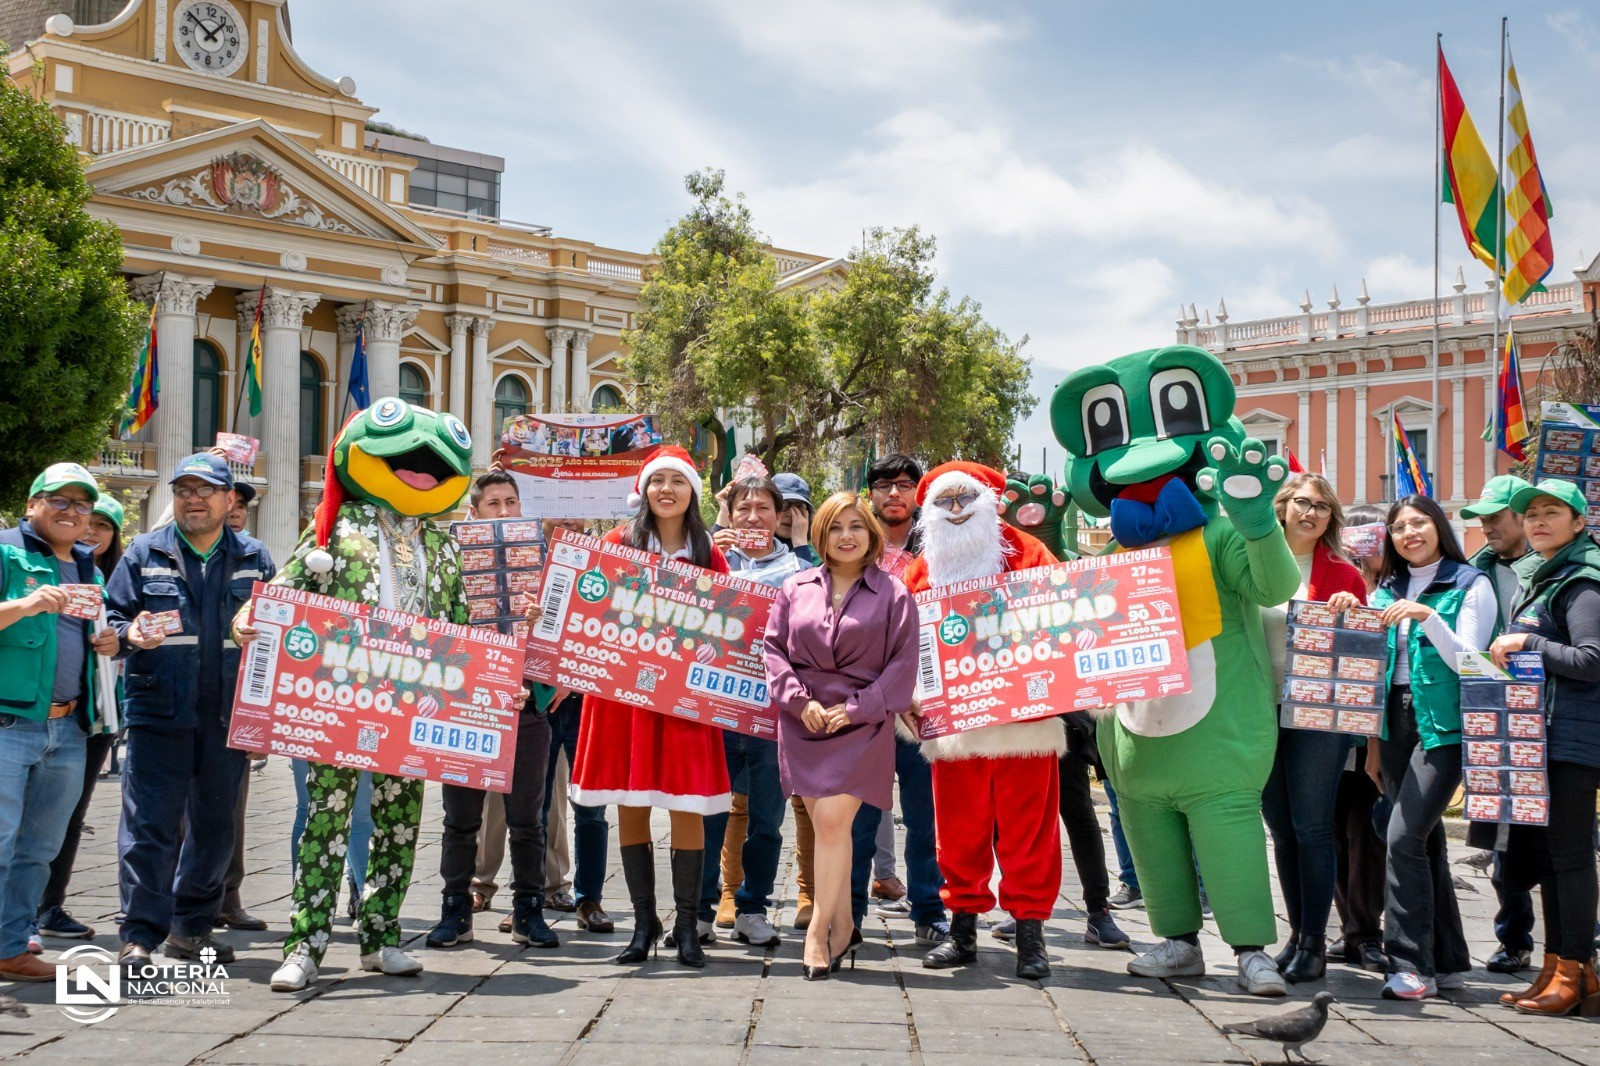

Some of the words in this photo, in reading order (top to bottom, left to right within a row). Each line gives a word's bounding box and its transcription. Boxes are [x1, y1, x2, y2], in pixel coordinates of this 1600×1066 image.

[206, 7, 217, 18] 12
[182, 26, 188, 36] 3
[230, 37, 236, 46] 9
[194, 52, 200, 60] 5
[205, 56, 211, 65] 6
[219, 56, 224, 64] 7
[226, 50, 232, 58] 8
[530, 456, 564, 468] 2025
[562, 530, 600, 550] LOTERIA
[602, 541, 651, 564] NACIONAL
[662, 558, 704, 579] LONABOL
[713, 574, 752, 592] LOTERIA
[753, 583, 778, 598] NACI
[1130, 565, 1147, 578] 27
[584, 573, 604, 582] PRECIO
[914, 587, 948, 604] OTERIA
[950, 574, 998, 598] NACIONAL
[1010, 564, 1055, 582] LONABOL
[1066, 555, 1108, 572] LOTERIA
[1110, 547, 1162, 564] NACIONAL
[580, 578, 604, 596] 50
[650, 584, 698, 606] LOTERÍA
[700, 599, 716, 610] DE
[1008, 590, 1059, 610] LOTERÍA
[1061, 588, 1077, 600] DE
[262, 585, 306, 604] LOTERIA
[308, 591, 361, 615] NACIONAL
[372, 607, 418, 627] LONABOL
[428, 620, 468, 638] LOTERIA
[470, 627, 518, 648] NACIONAL
[611, 586, 745, 640] NAVIDAD
[975, 594, 1117, 640] NAVIDAD
[1128, 608, 1150, 622] 90
[292, 630, 312, 638] PRECIO
[566, 612, 674, 657] 500.000
[944, 624, 966, 640] 50
[288, 635, 314, 654] 50
[362, 636, 414, 656] LOTERÍA
[416, 648, 432, 660] DE
[562, 639, 621, 664] 50.000
[486, 648, 500, 661] 27
[944, 641, 1052, 680] 500.000
[323, 640, 464, 690] NAVIDAD
[559, 657, 608, 678] 20.000
[744, 660, 764, 670] 1.000
[556, 674, 596, 690] 10.000
[948, 676, 1006, 700] 50.000
[277, 672, 393, 712] 500.000
[391, 707, 404, 716] Bs.
[472, 692, 492, 706] 90
[614, 688, 648, 704] 5.000
[274, 702, 338, 726] 50.000
[450, 702, 482, 712] AGUINALDOS
[950, 696, 998, 716] 20.000
[1010, 703, 1047, 718] 5.000
[468, 711, 488, 720] 1.000
[952, 714, 992, 730] 10.000
[272, 722, 326, 742] 20.000
[416, 724, 492, 752] 27124
[270, 740, 314, 756] 10.000
[335, 751, 372, 766] 5.000
